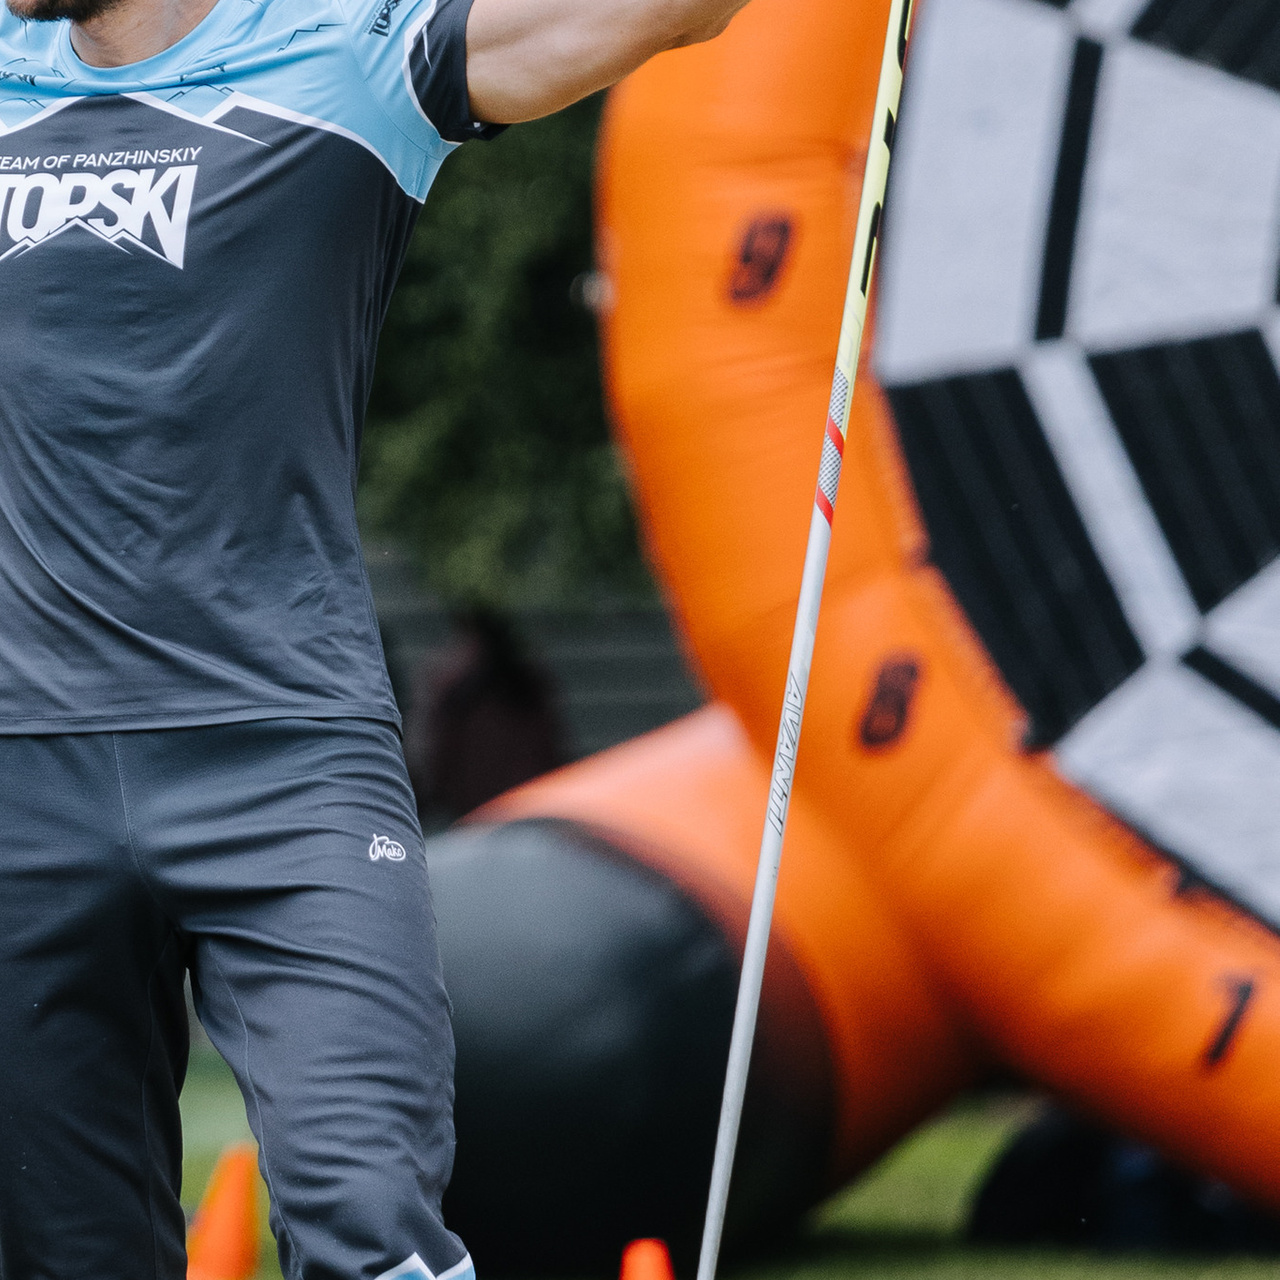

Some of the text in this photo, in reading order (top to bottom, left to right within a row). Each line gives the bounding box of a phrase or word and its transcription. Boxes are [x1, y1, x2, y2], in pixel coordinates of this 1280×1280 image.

[43, 153, 70, 170] OF
[73, 146, 202, 168] PANZHINSKIY
[768, 672, 803, 837] AVANTI
